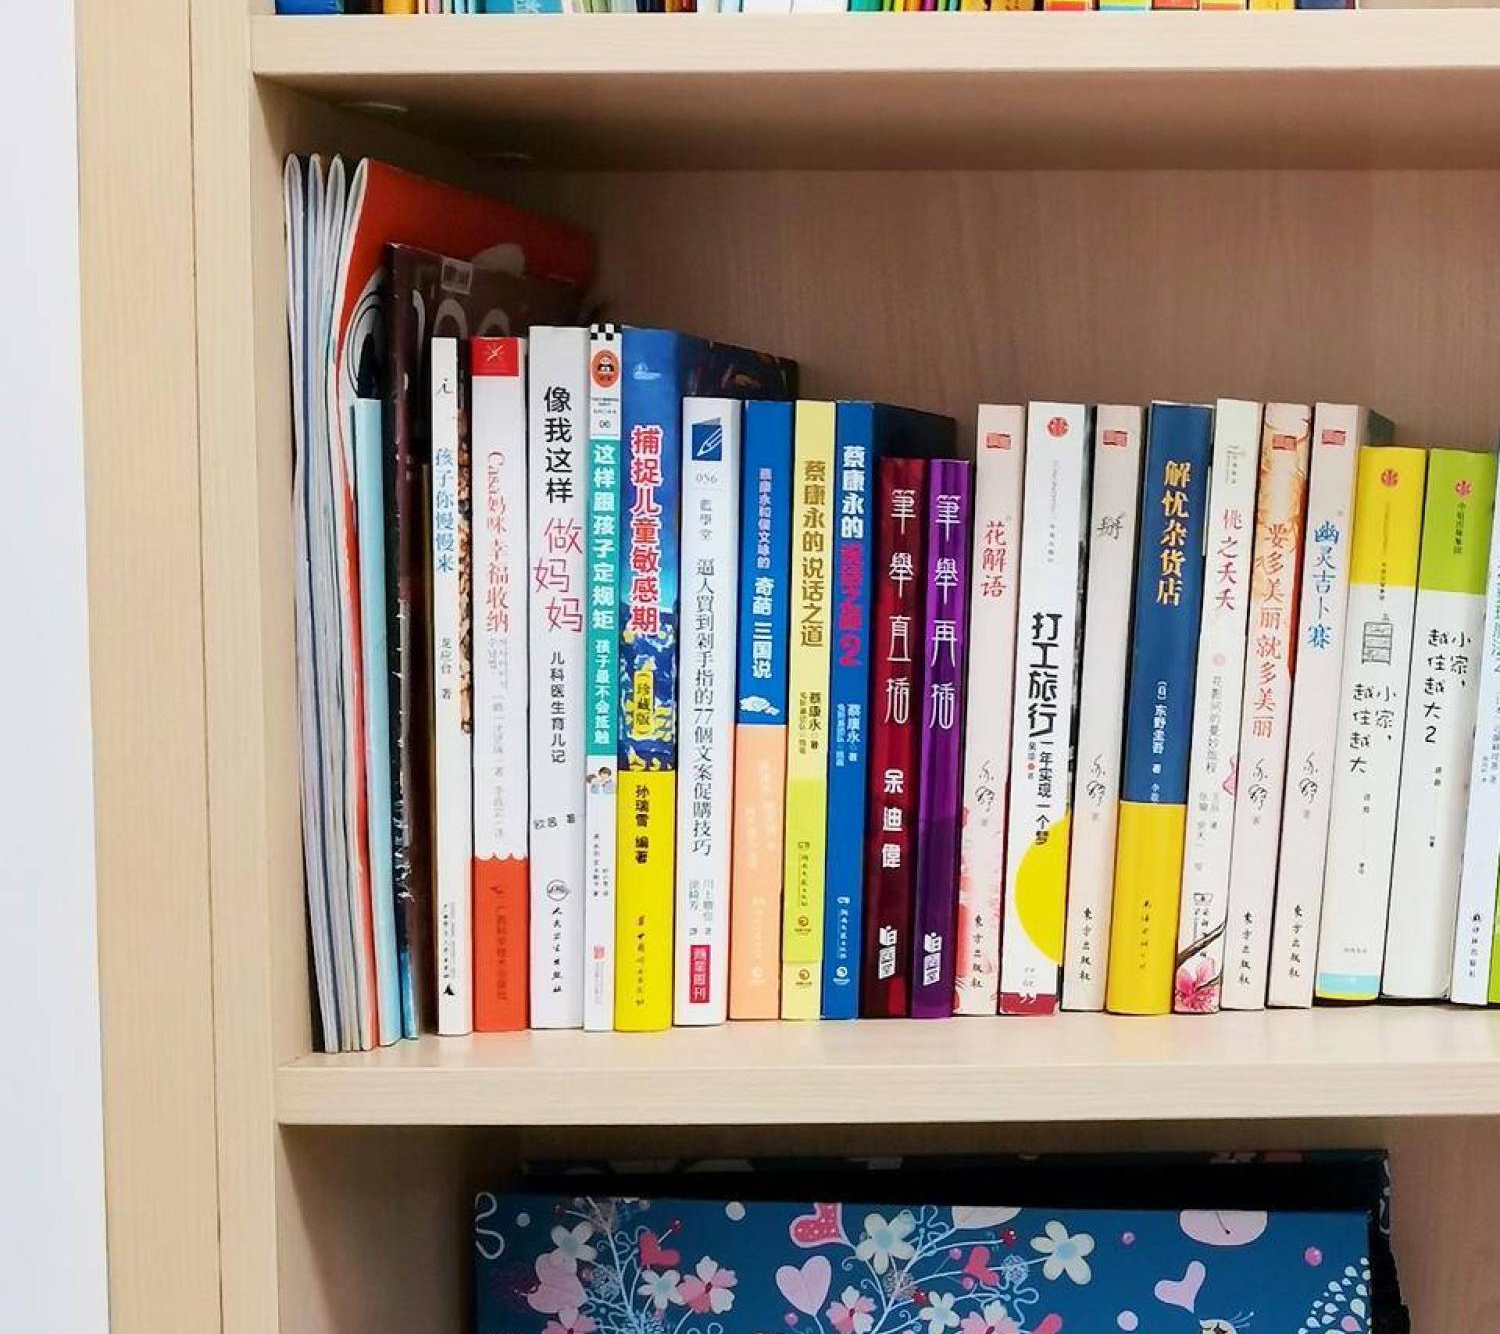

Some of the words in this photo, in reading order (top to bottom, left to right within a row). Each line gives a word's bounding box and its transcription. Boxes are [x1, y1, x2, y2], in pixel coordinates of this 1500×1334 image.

[543, 385, 574, 505] 像我这样
[434, 447, 456, 575] 孩子你慢慢来
[592, 443, 616, 631] 这样跟孩子定规矩
[630, 425, 663, 637] 捕捉儿童敏感期
[799, 459, 827, 649] 蔡康永的说话之道
[980, 519, 1009, 599] 花解语
[1155, 459, 1192, 608] 解忧杂货店
[1214, 508, 1244, 612] 桃之夭夭
[532, 515, 585, 634] 做妈妈
[1252, 523, 1289, 741] 要多美丽就多美丽
[1306, 519, 1340, 652] 幽灵吉卜赛
[549, 651, 567, 765] 儿科医生育儿记
[808, 691, 823, 733] 蔡康永
[1026, 611, 1064, 739] 打工旅行
[1152, 702, 1168, 755] 东野圭吾
[1348, 682, 1375, 775] 越住越大
[1422, 627, 1450, 745] 越住越大2
[634, 784, 650, 828] 孙瑞雪
